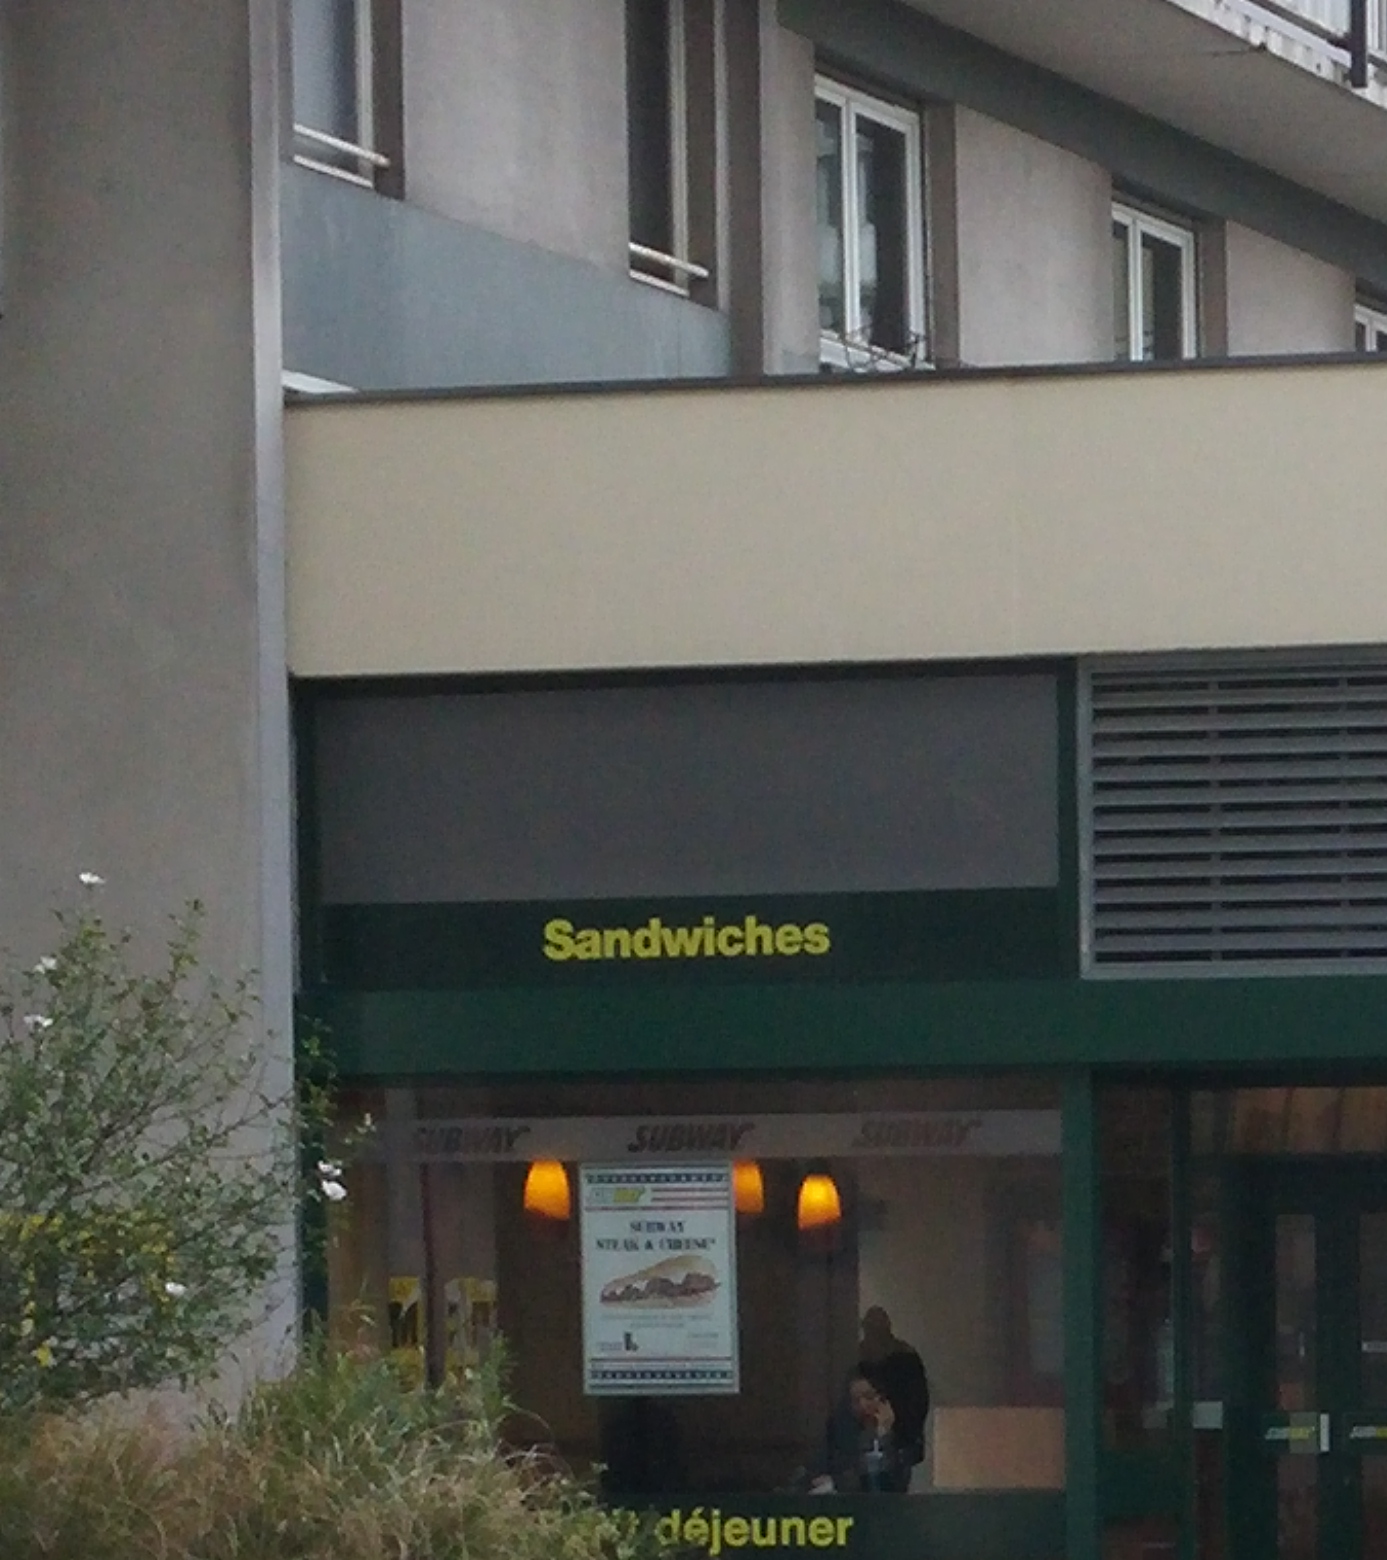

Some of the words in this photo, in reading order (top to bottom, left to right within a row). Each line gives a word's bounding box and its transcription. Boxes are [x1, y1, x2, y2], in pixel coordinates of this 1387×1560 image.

[543, 915, 831, 961] Sandwiches
[627, 1122, 756, 1153] SUBWAY
[655, 1506, 855, 1556] déjeuner
